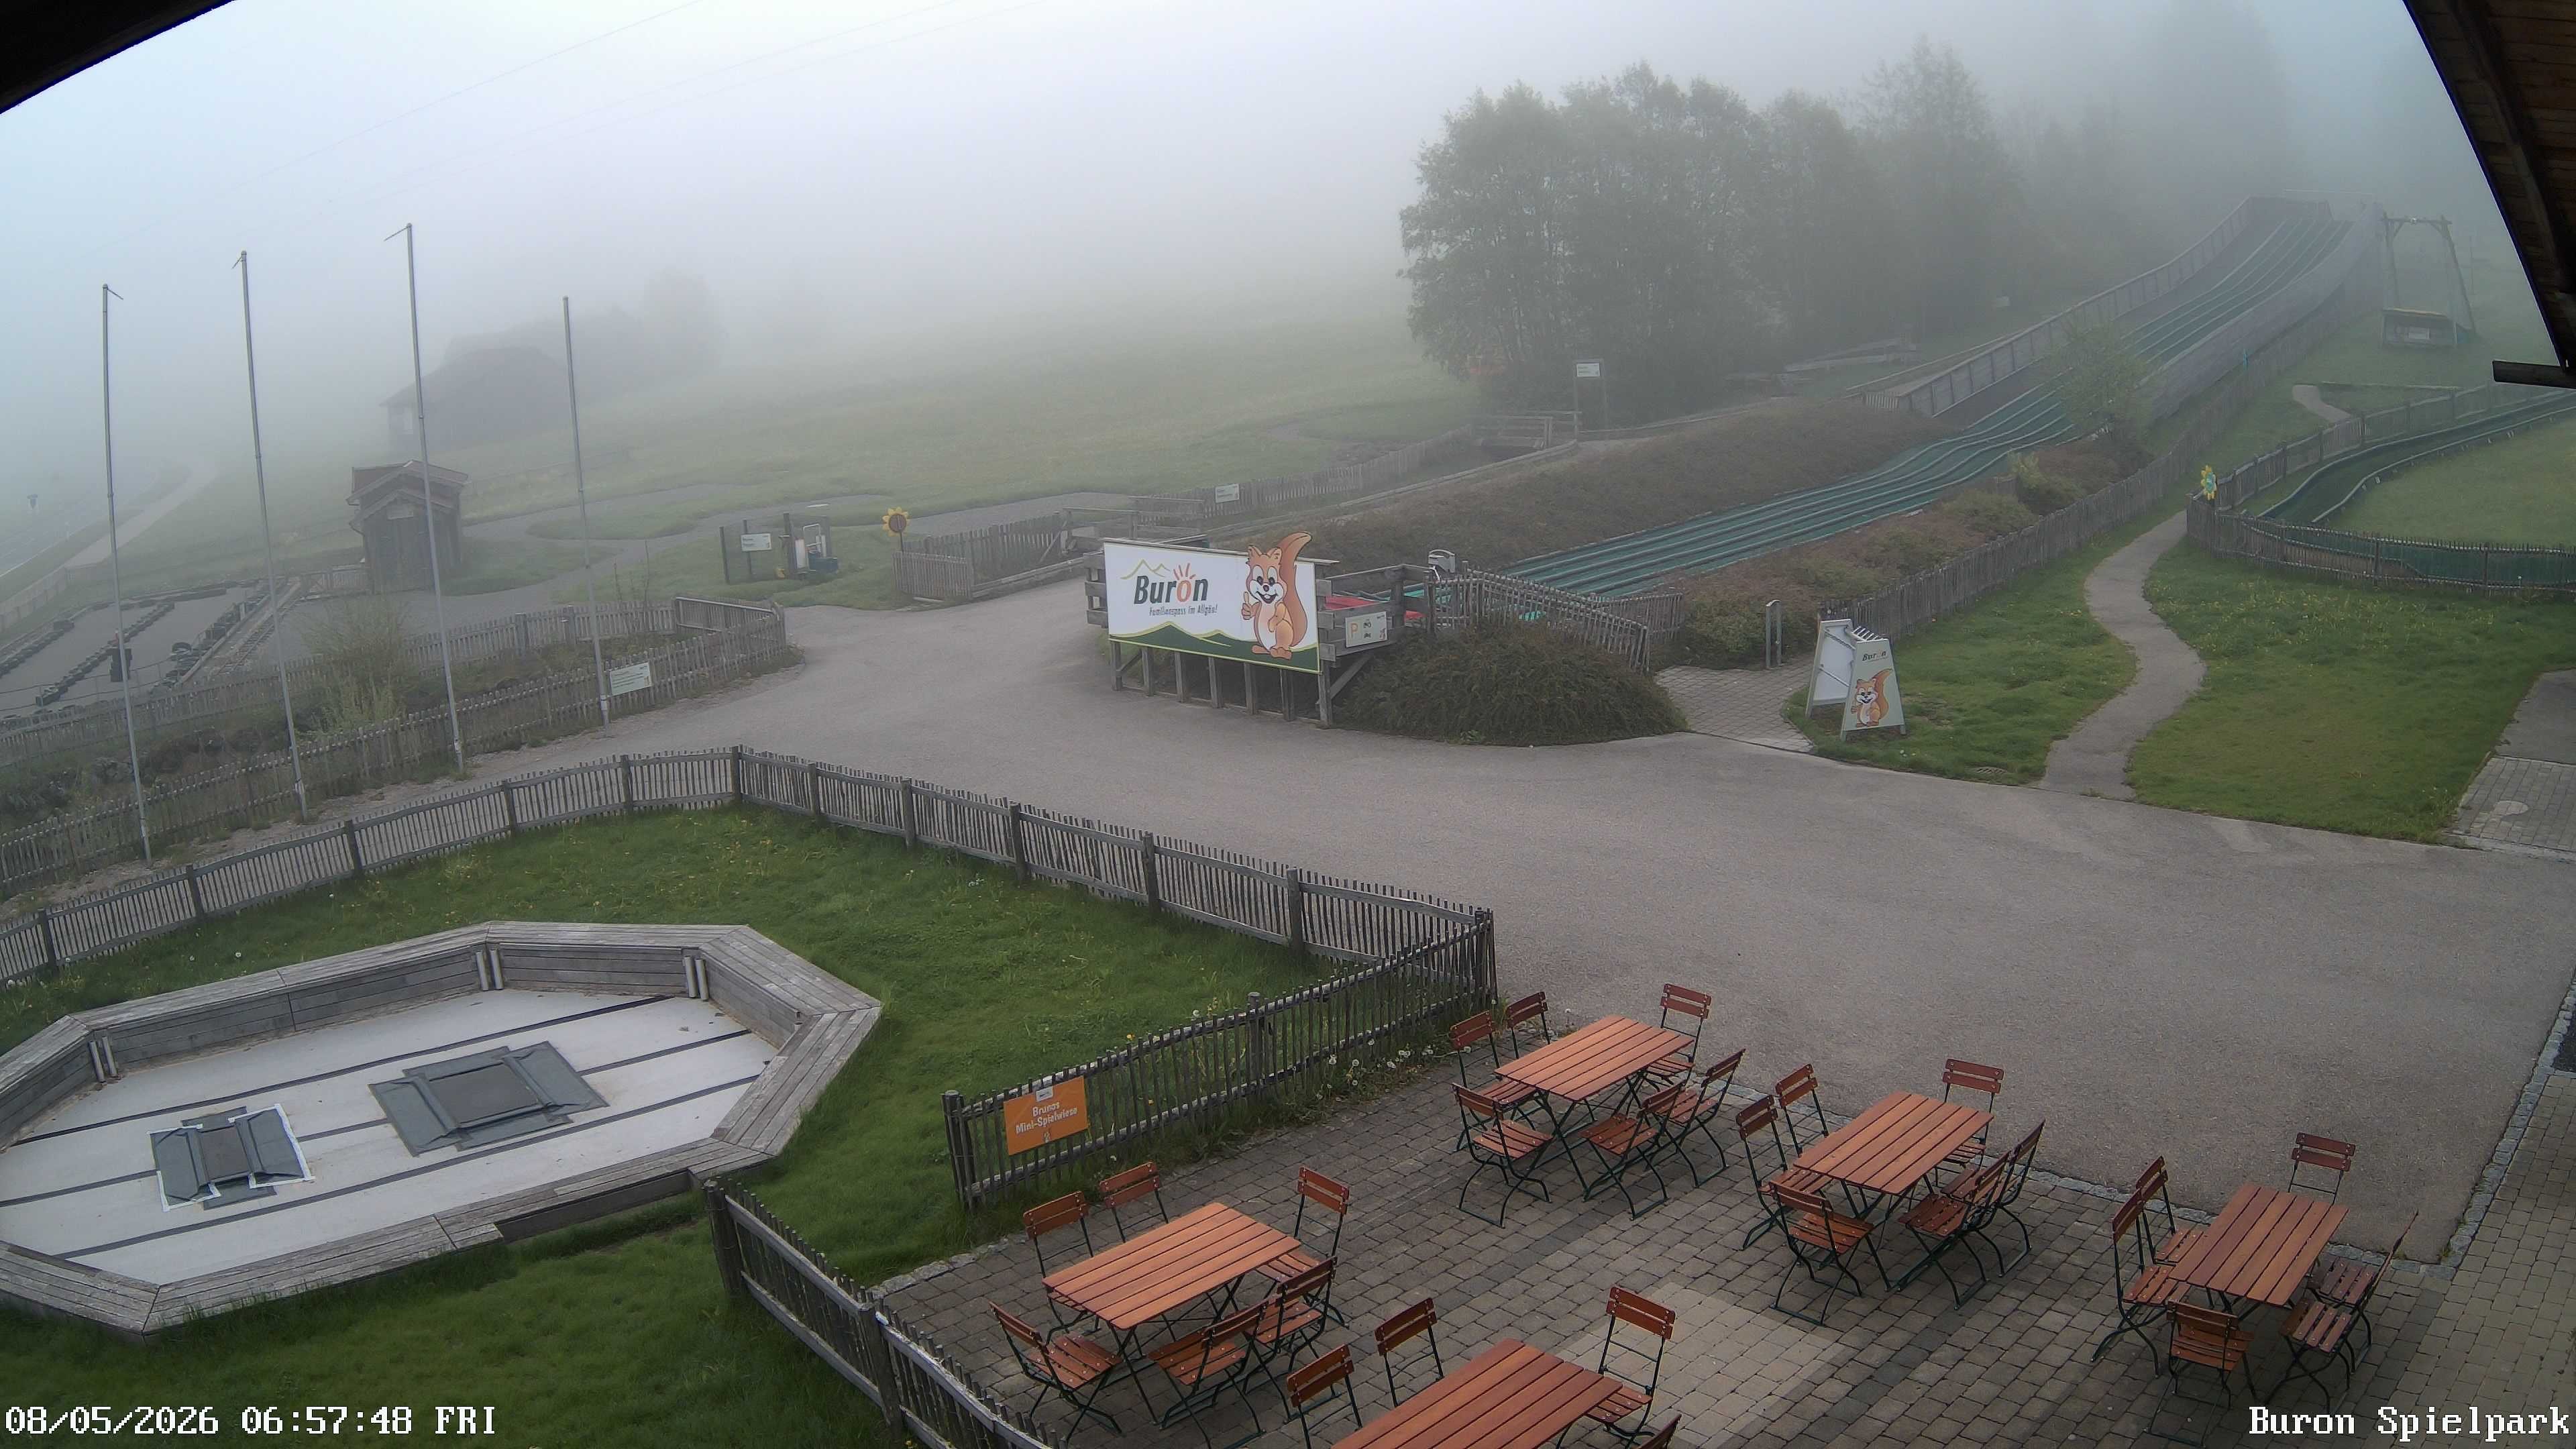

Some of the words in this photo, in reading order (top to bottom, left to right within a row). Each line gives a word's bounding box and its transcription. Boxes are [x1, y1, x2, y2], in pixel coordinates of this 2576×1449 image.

[1134, 576, 1208, 604] Buron
[1862, 650, 1886, 661] Burn
[1032, 1102, 1060, 1117] Brunos
[1016, 1107, 1077, 1134] Mini-Spielwiese
